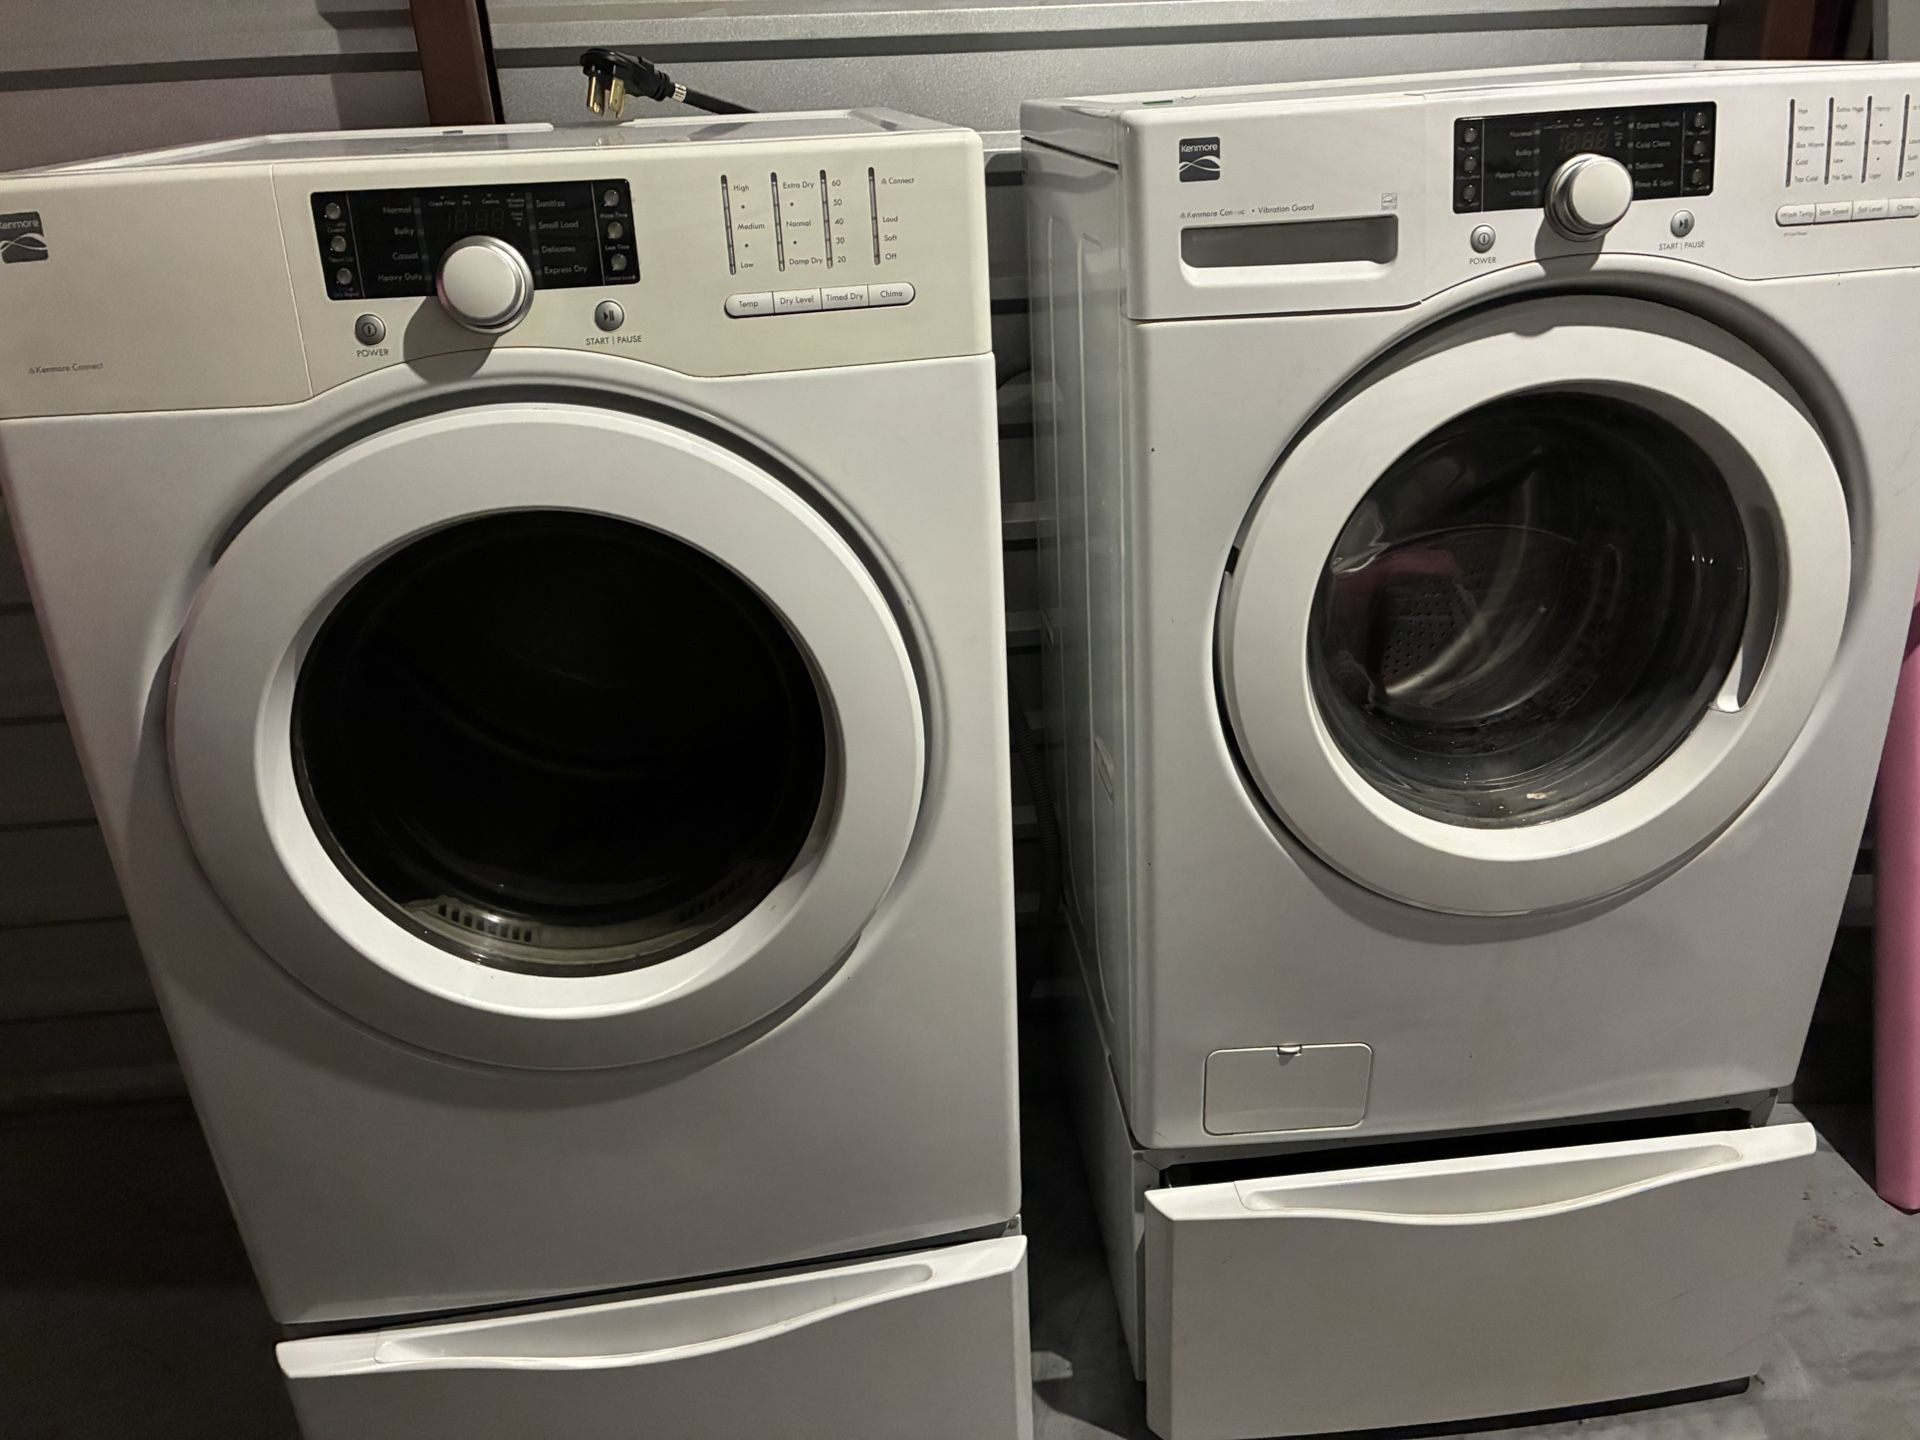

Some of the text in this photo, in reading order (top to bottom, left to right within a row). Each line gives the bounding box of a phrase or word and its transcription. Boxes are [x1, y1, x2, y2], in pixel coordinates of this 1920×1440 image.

[1181, 143, 1218, 152] Kenmore
[733, 184, 750, 192] High
[802, 181, 814, 190] Dry
[383, 206, 412, 214] Normal
[1292, 204, 1314, 212] Guard
[538, 220, 579, 229] Small Load
[738, 222, 765, 230] Medium
[786, 220, 812, 228] Normal
[394, 228, 414, 236] Bulky
[1659, 241, 1705, 250] START PAUSE
[392, 252, 418, 261] Casual
[789, 256, 822, 266] Damp Dry
[1469, 256, 1496, 264] POWER
[544, 265, 588, 275] Express Dry
[378, 274, 402, 282] Heavy
[780, 295, 814, 305] Dry Level
[826, 292, 864, 302] Timed Dry
[738, 300, 758, 309] Temp
[586, 335, 642, 346] START PAUSE
[356, 349, 389, 358] POWER
[36, 363, 104, 374] Kenmore Connect
